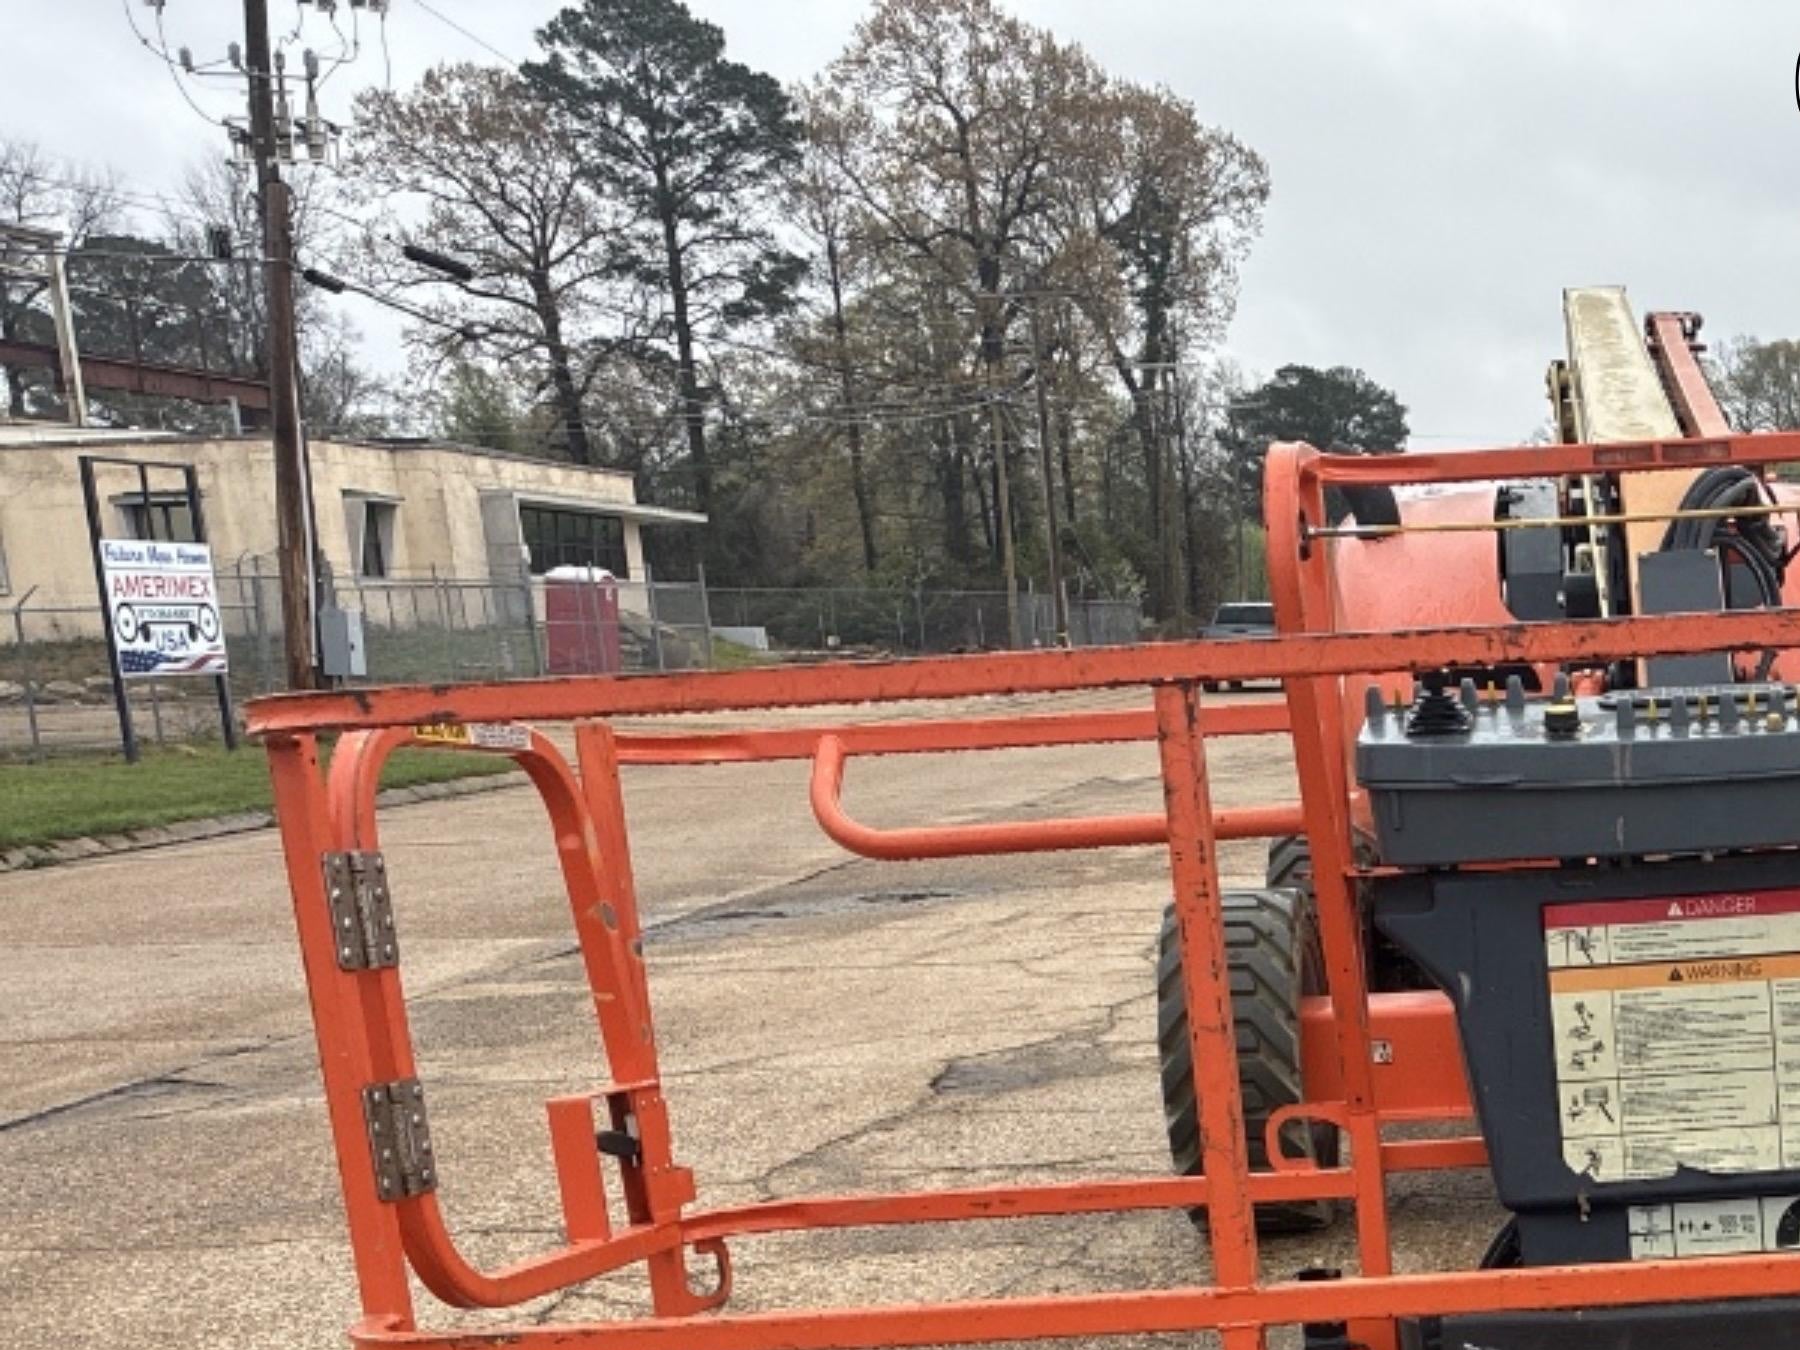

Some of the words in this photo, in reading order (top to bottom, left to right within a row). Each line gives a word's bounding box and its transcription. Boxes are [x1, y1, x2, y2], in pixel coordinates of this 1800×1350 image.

[112, 574, 212, 599] AMERIMEX
[155, 629, 190, 652] USA
[1685, 896, 1757, 917] DANGER
[1685, 959, 1763, 981] WARNING
